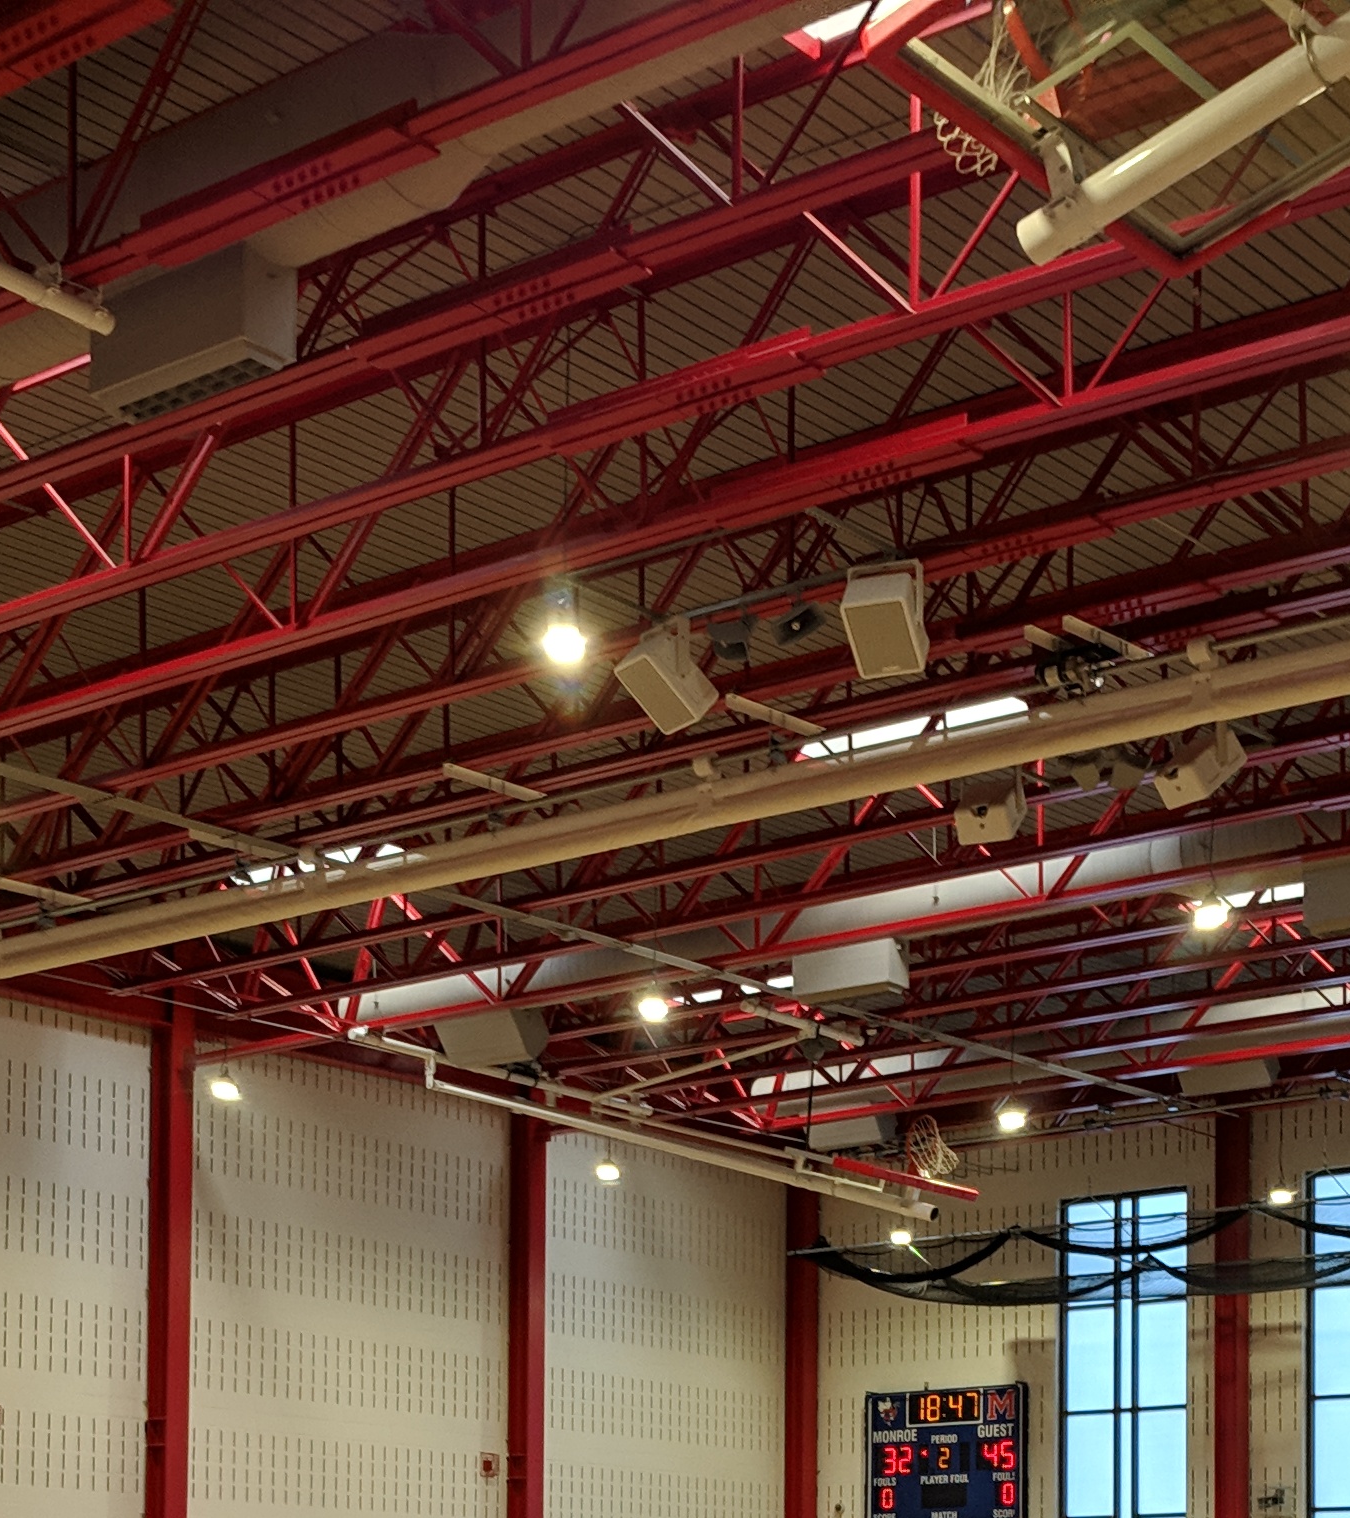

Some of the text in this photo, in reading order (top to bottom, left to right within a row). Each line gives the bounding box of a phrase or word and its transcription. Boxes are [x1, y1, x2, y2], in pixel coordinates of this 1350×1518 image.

[920, 1393, 979, 1422] 18:47
[986, 1389, 1016, 1420] M
[873, 1428, 918, 1444] MONROE
[931, 1433, 958, 1444] PERIOD
[977, 1423, 1015, 1439] GUEST
[883, 1446, 913, 1474] 32
[938, 1446, 951, 1469] 2
[983, 1440, 1015, 1469] 45
[873, 1476, 897, 1487] FOULS
[920, 1473, 969, 1485] PLAYER FOUL
[882, 1488, 894, 1509] 0
[1002, 1483, 1014, 1504] 0
